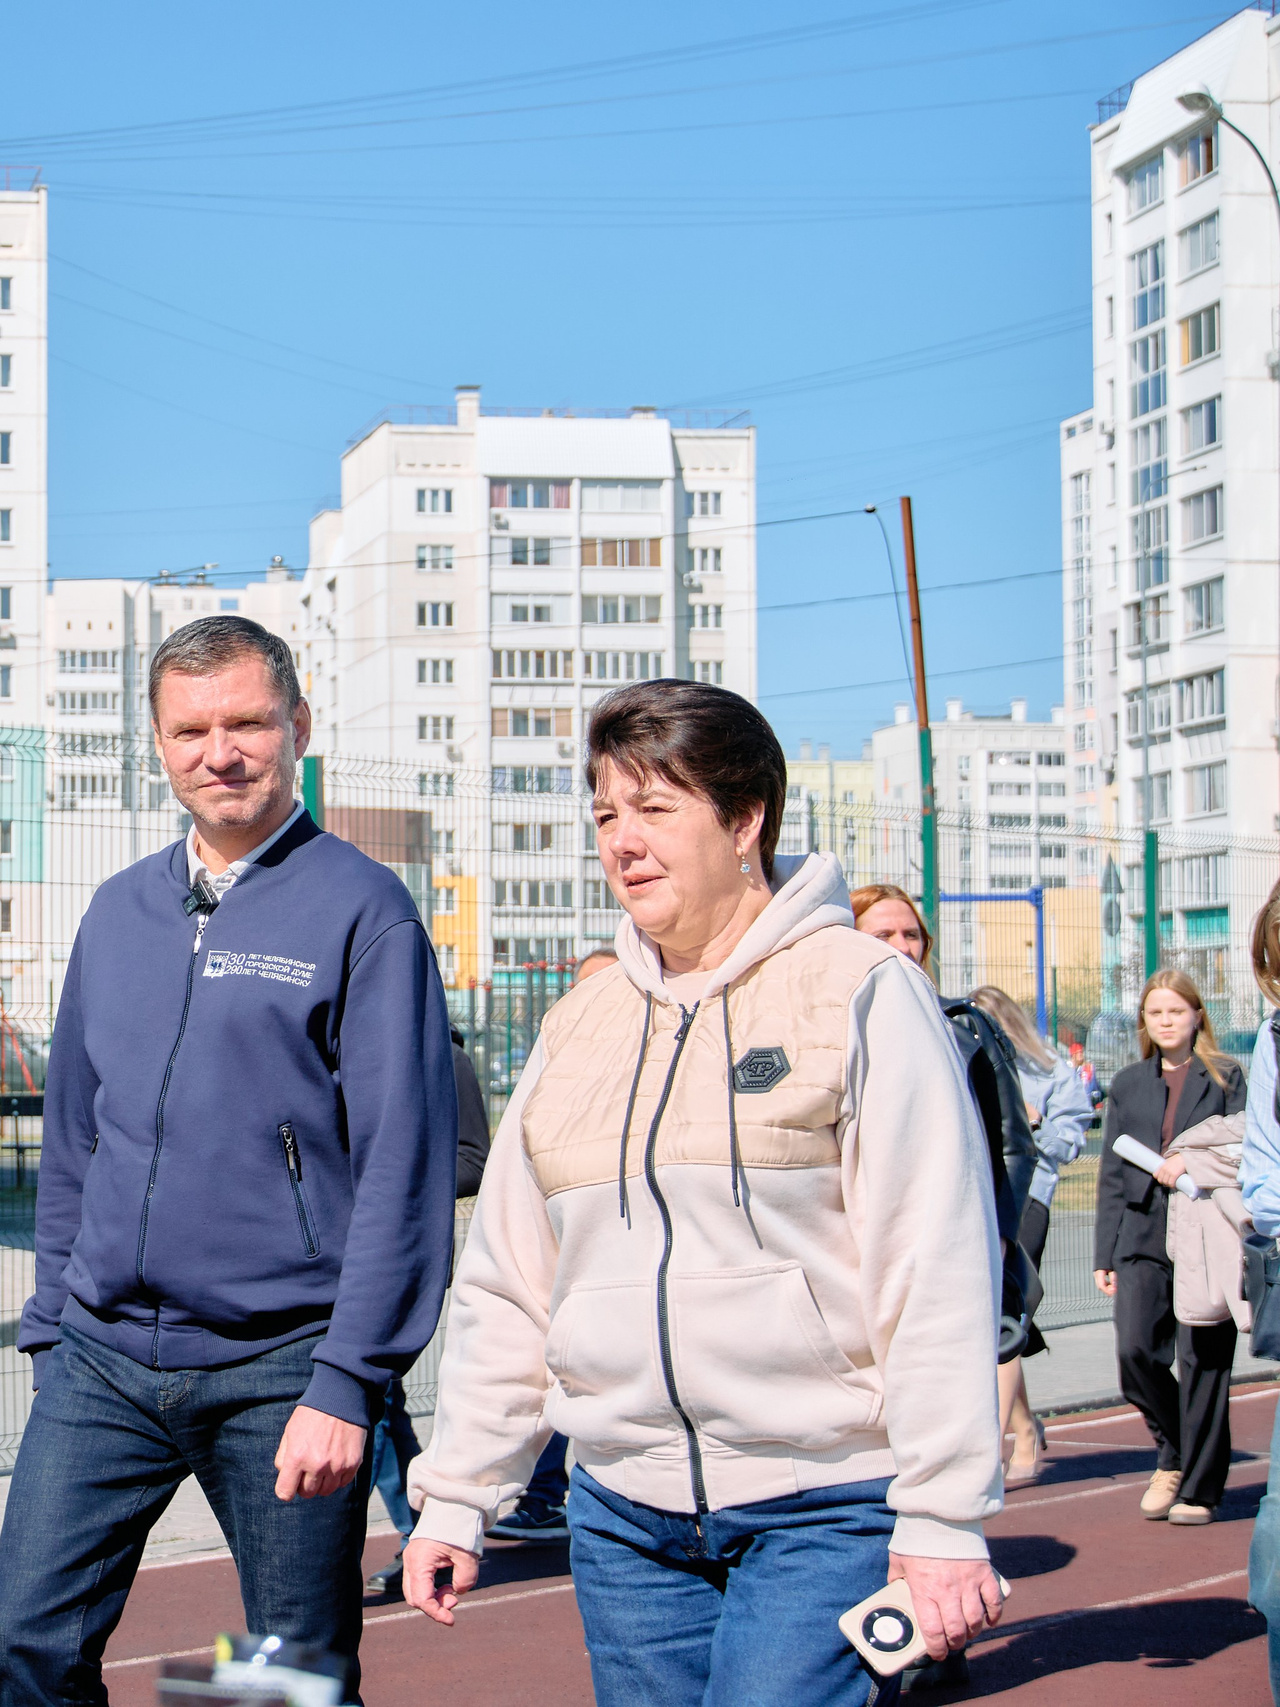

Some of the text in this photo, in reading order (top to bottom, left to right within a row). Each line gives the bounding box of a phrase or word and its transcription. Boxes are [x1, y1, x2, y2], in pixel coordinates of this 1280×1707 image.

[228, 953, 245, 965] 30
[263, 954, 316, 971] ЧЕЛЯБИНСКОЙ
[245, 960, 313, 979] ГОРОДСКОЙ ДУМЕ
[226, 965, 311, 987] 290 ЛЕТ ЧЕЛЯБИНСКУ
